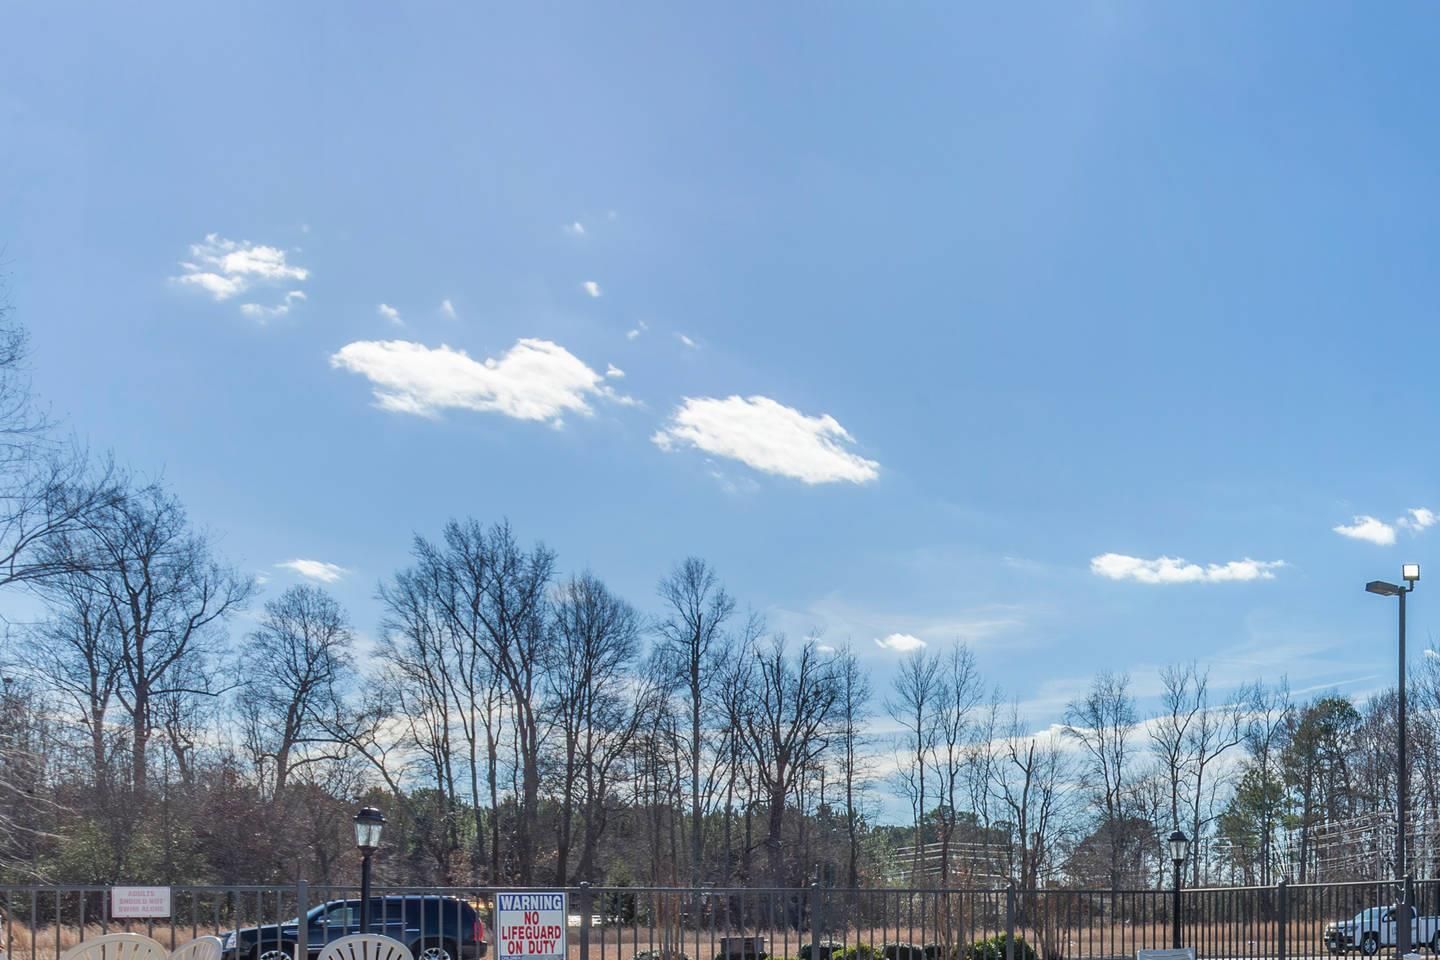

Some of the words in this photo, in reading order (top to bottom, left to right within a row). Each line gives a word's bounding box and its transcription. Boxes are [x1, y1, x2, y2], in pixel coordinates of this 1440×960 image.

[500, 895, 561, 910] WARNING
[524, 911, 540, 925] NO
[501, 925, 562, 940] LIFEGUARD
[507, 940, 523, 955] ON
[528, 940, 556, 954] DUTY
